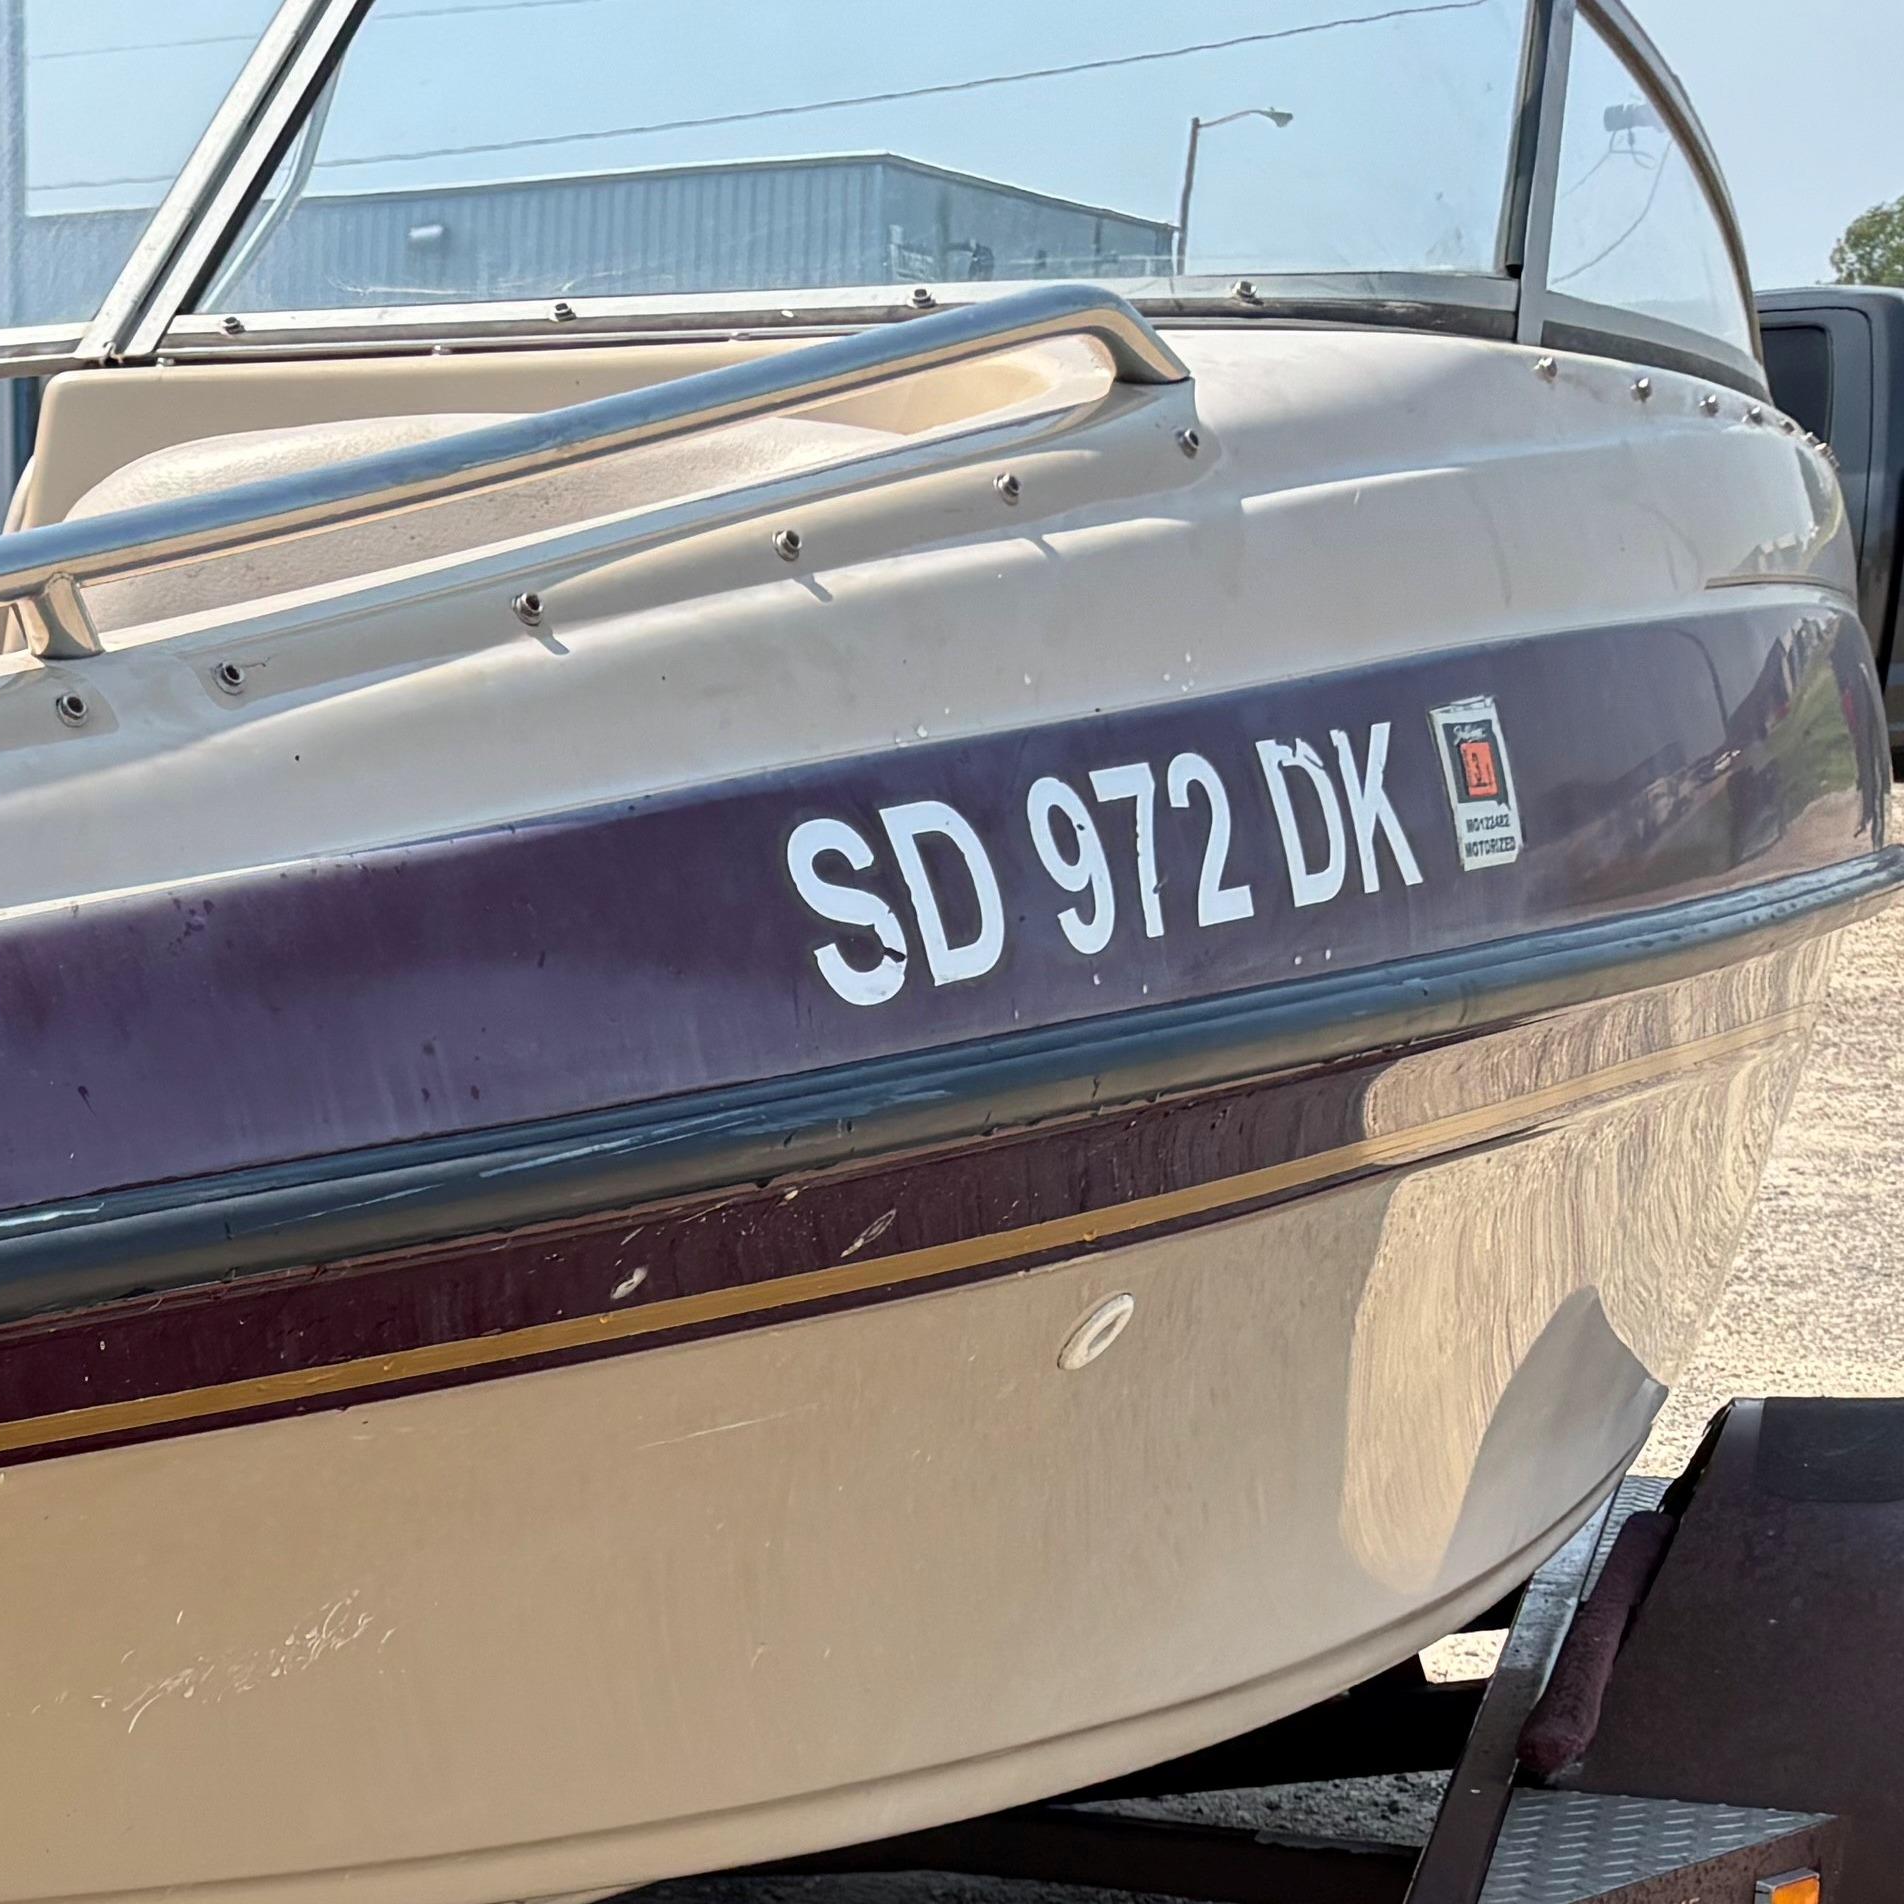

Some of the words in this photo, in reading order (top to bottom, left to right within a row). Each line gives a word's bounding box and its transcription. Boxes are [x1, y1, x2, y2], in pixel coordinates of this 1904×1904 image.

[786, 799, 1005, 1006] SD
[1026, 753, 1256, 955] 972
[1256, 721, 1424, 908] DK
